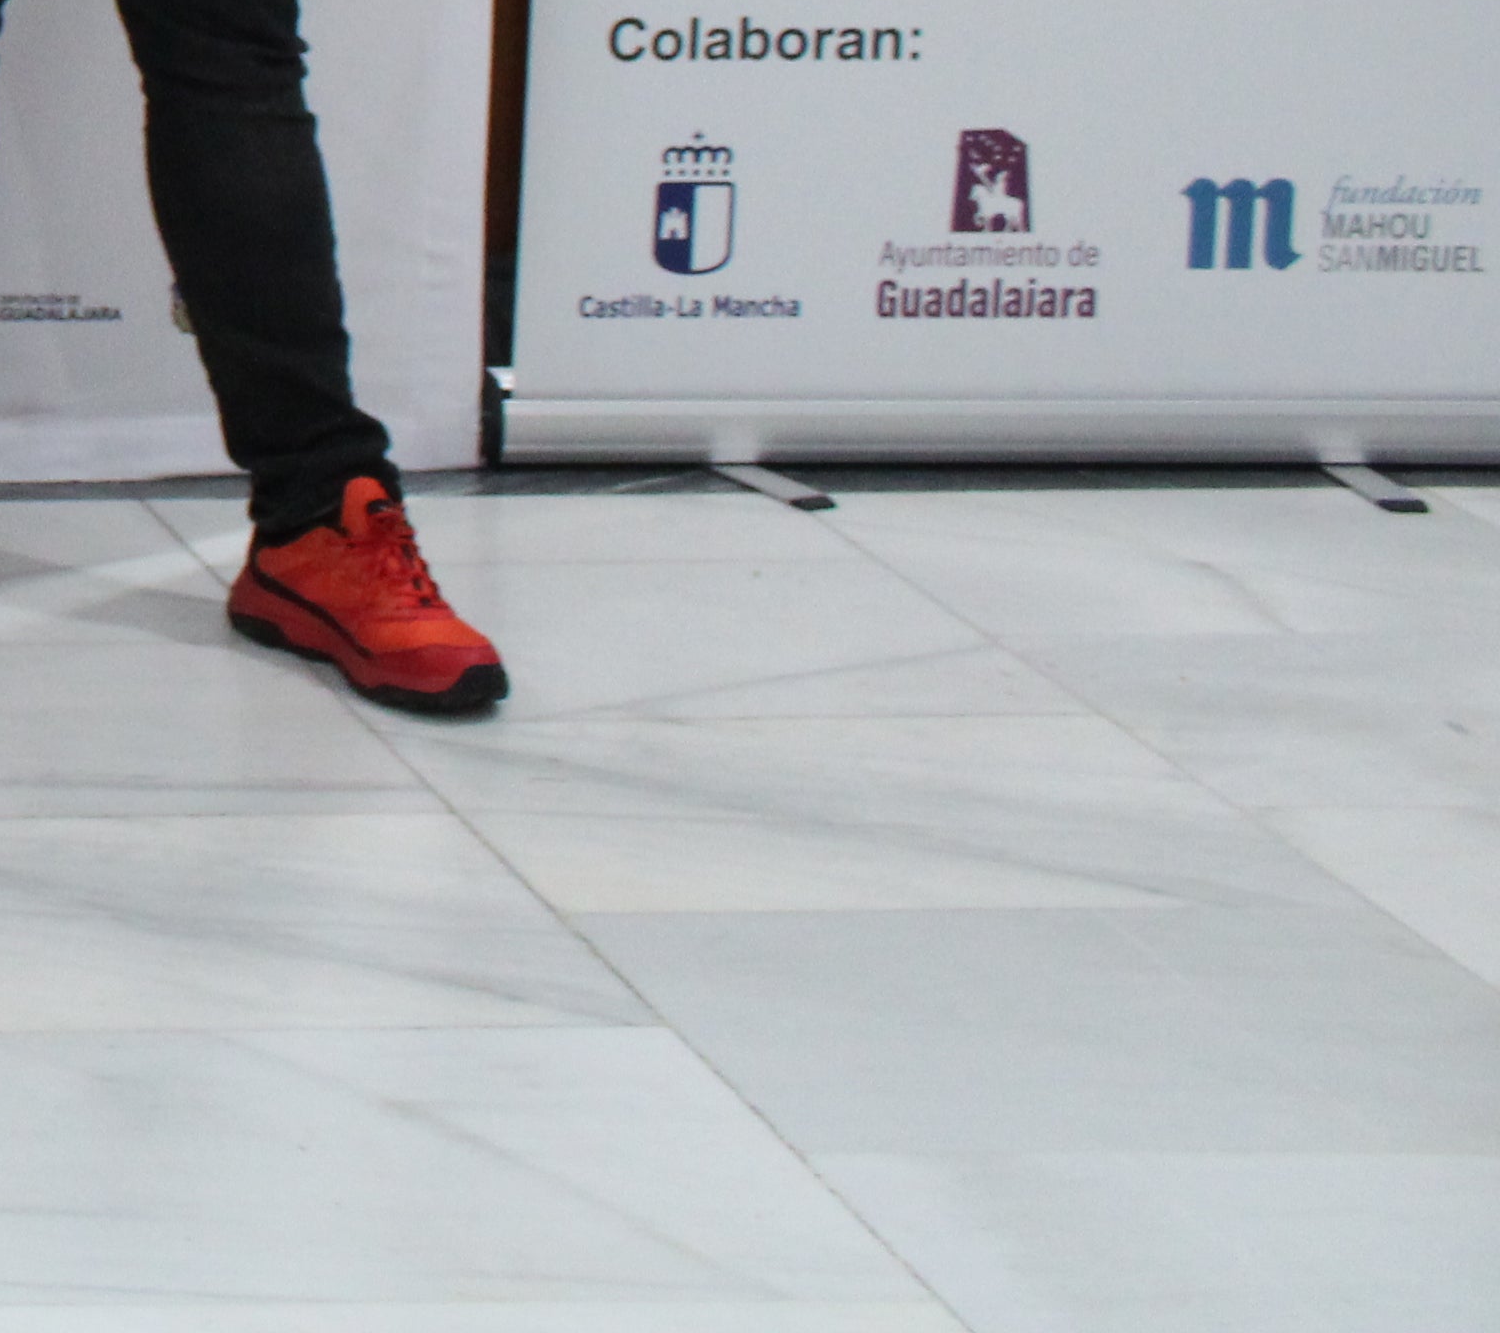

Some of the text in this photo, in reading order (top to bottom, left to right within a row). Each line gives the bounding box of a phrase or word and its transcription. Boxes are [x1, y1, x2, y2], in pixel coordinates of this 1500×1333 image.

[607, 15, 922, 63] Colaboran:
[1320, 174, 1484, 215] fundación
[1321, 214, 1431, 239] MAHOU
[878, 239, 1099, 272] Ayuntamiento de
[577, 294, 802, 319] Castilla-La Mancha
[875, 277, 1098, 319] Guadalajara
